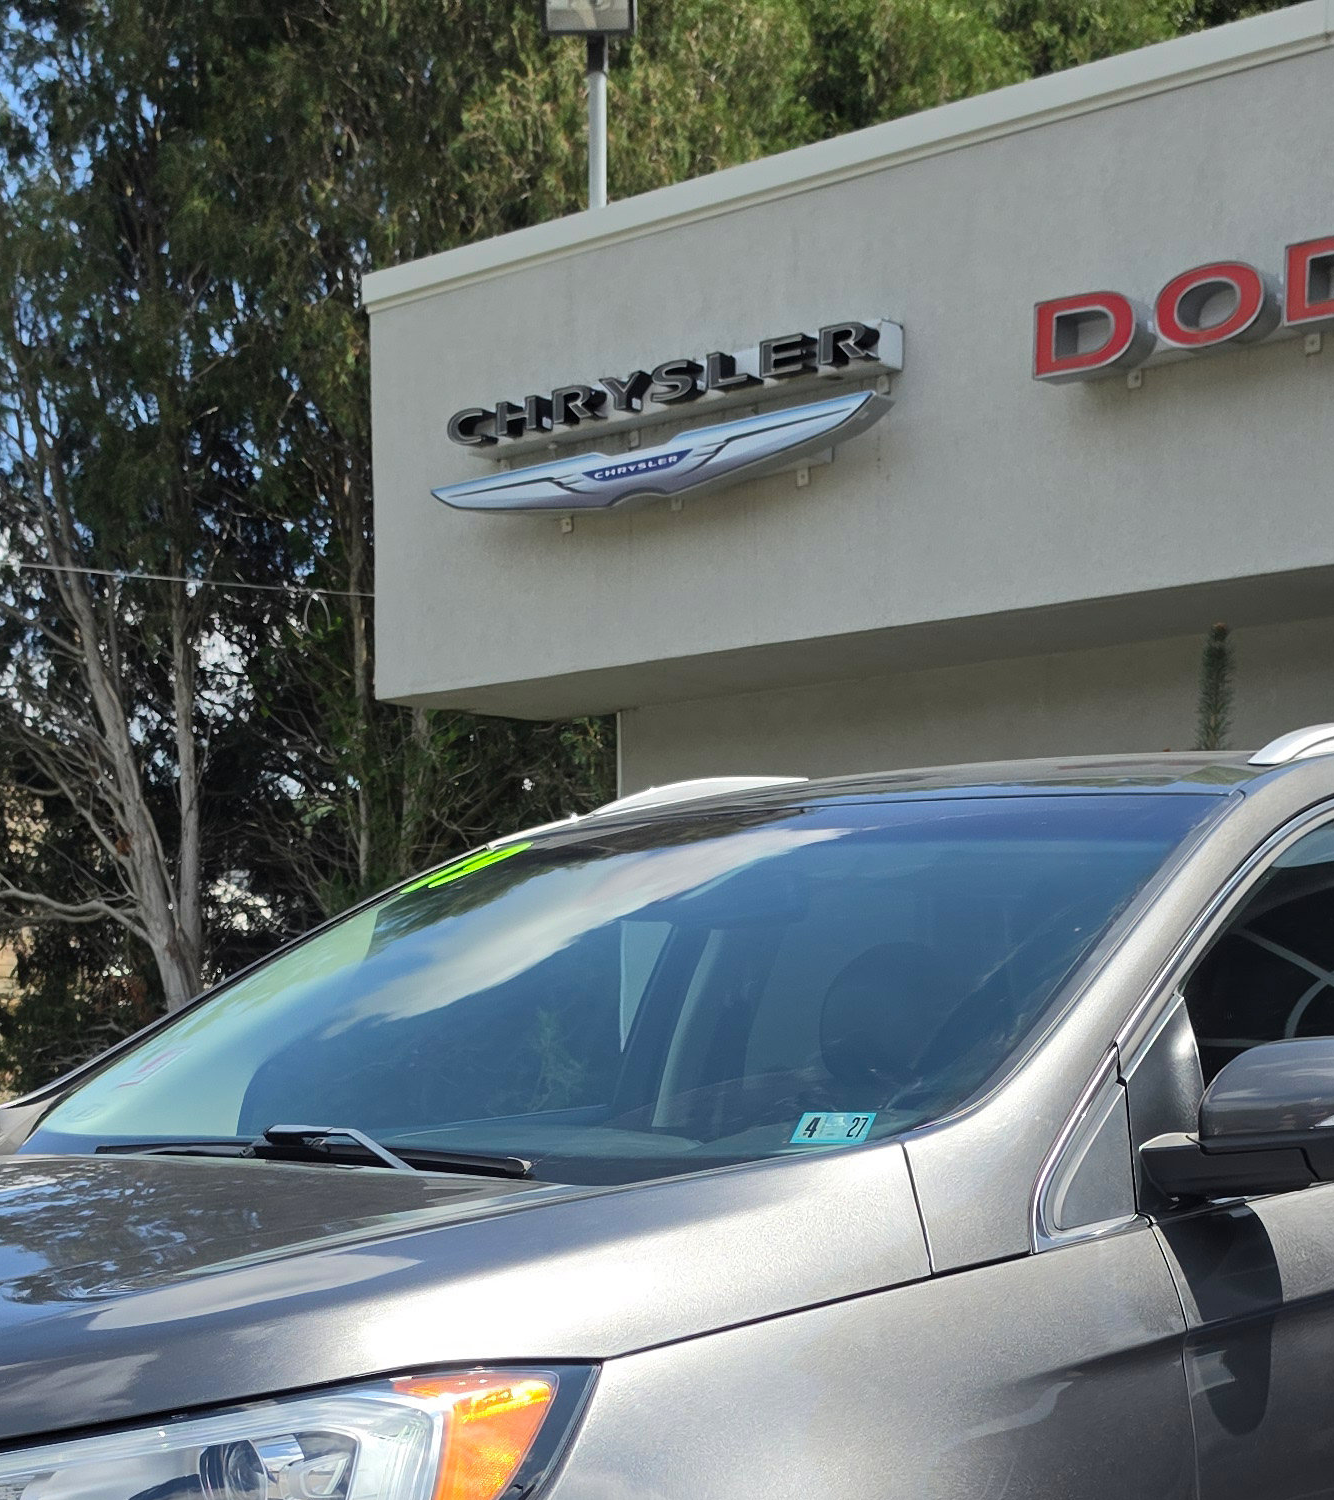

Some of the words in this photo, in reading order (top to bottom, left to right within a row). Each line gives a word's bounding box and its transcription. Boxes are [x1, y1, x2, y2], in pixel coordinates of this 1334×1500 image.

[446, 320, 880, 447] CHRYSLER
[593, 455, 678, 479] CHRYSLER
[804, 1116, 822, 1139] 4
[846, 1116, 869, 1139] 27
